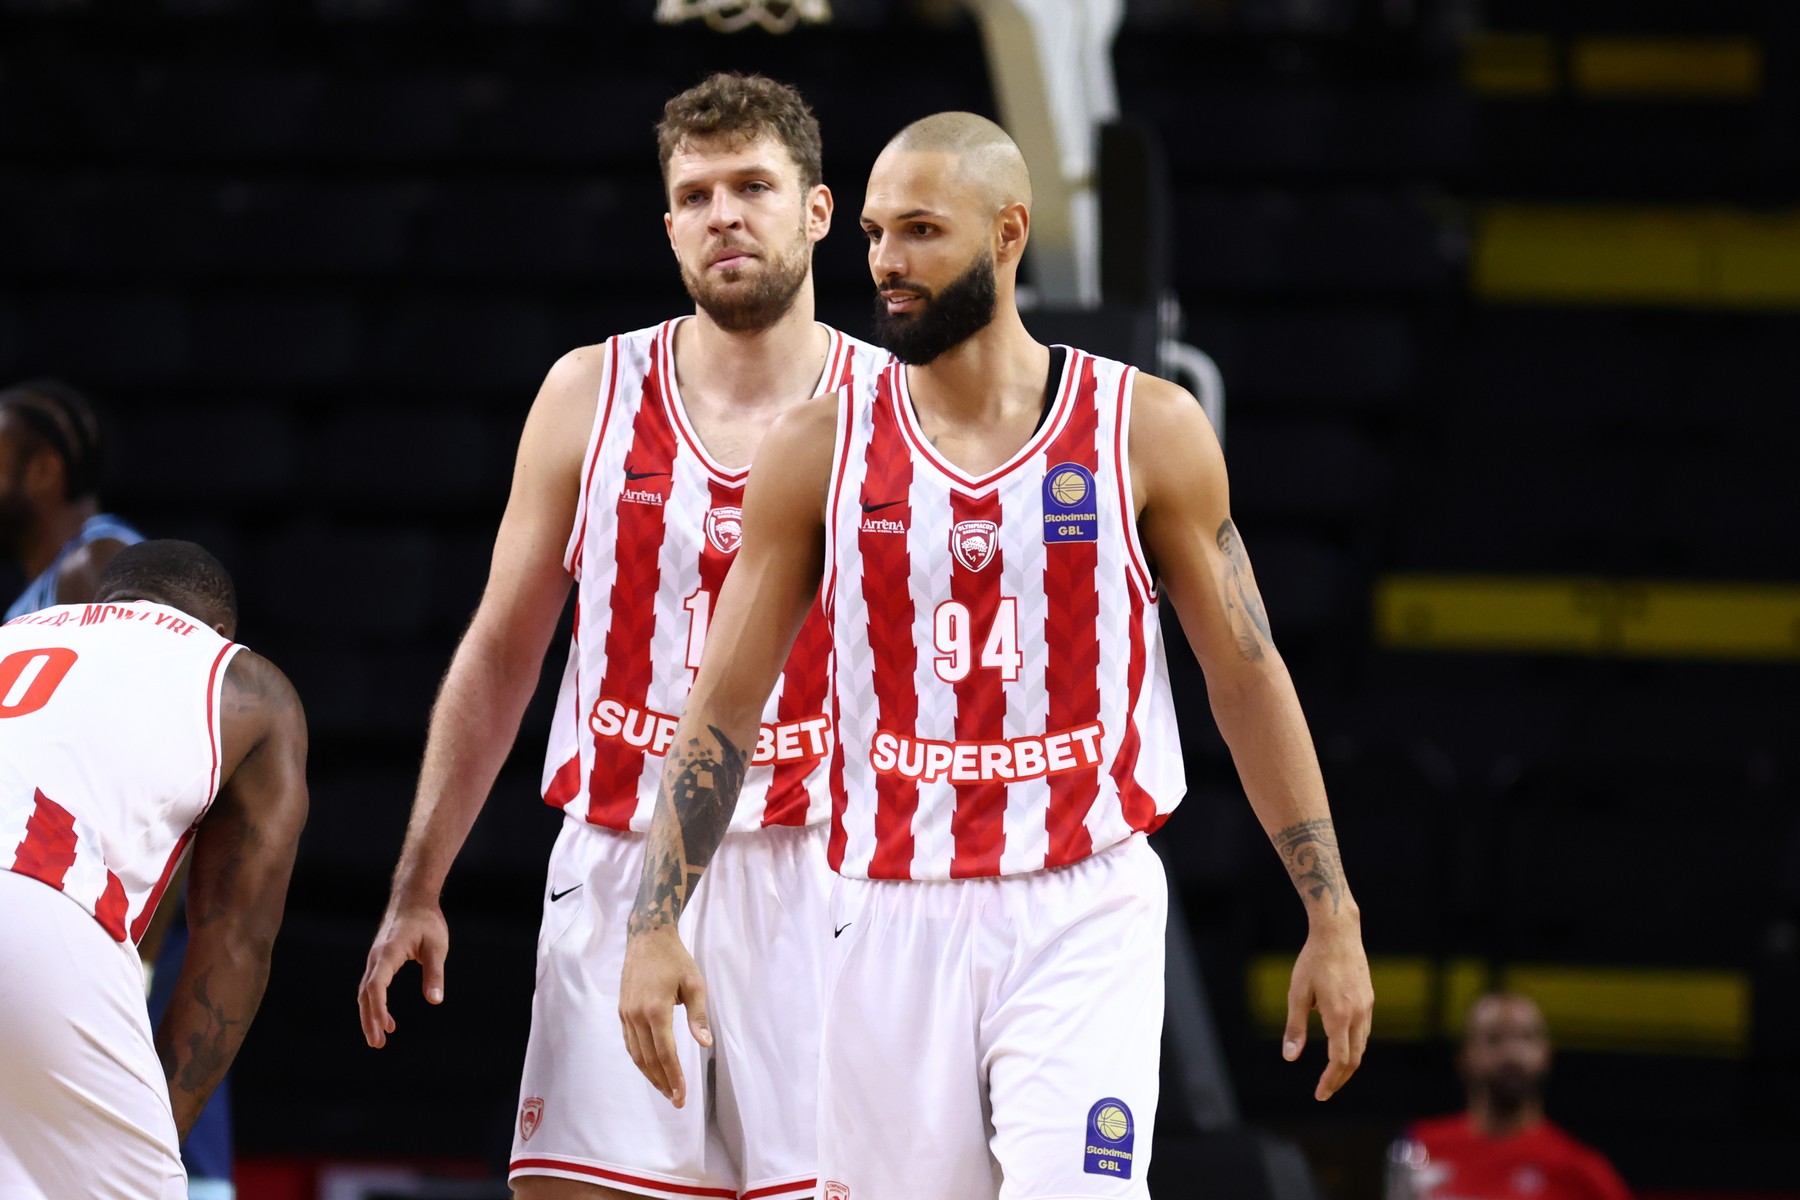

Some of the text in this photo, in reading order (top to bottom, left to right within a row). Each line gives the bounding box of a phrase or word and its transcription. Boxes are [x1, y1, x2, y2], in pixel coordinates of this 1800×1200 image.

[1058, 525, 1084, 536] GBL
[684, 588, 710, 669] 1
[933, 597, 1023, 683] 94
[0, 647, 78, 719] 0
[590, 697, 831, 766] SUPBET
[871, 721, 1104, 783] SUPERBET
[1098, 1159, 1121, 1171] GBL
